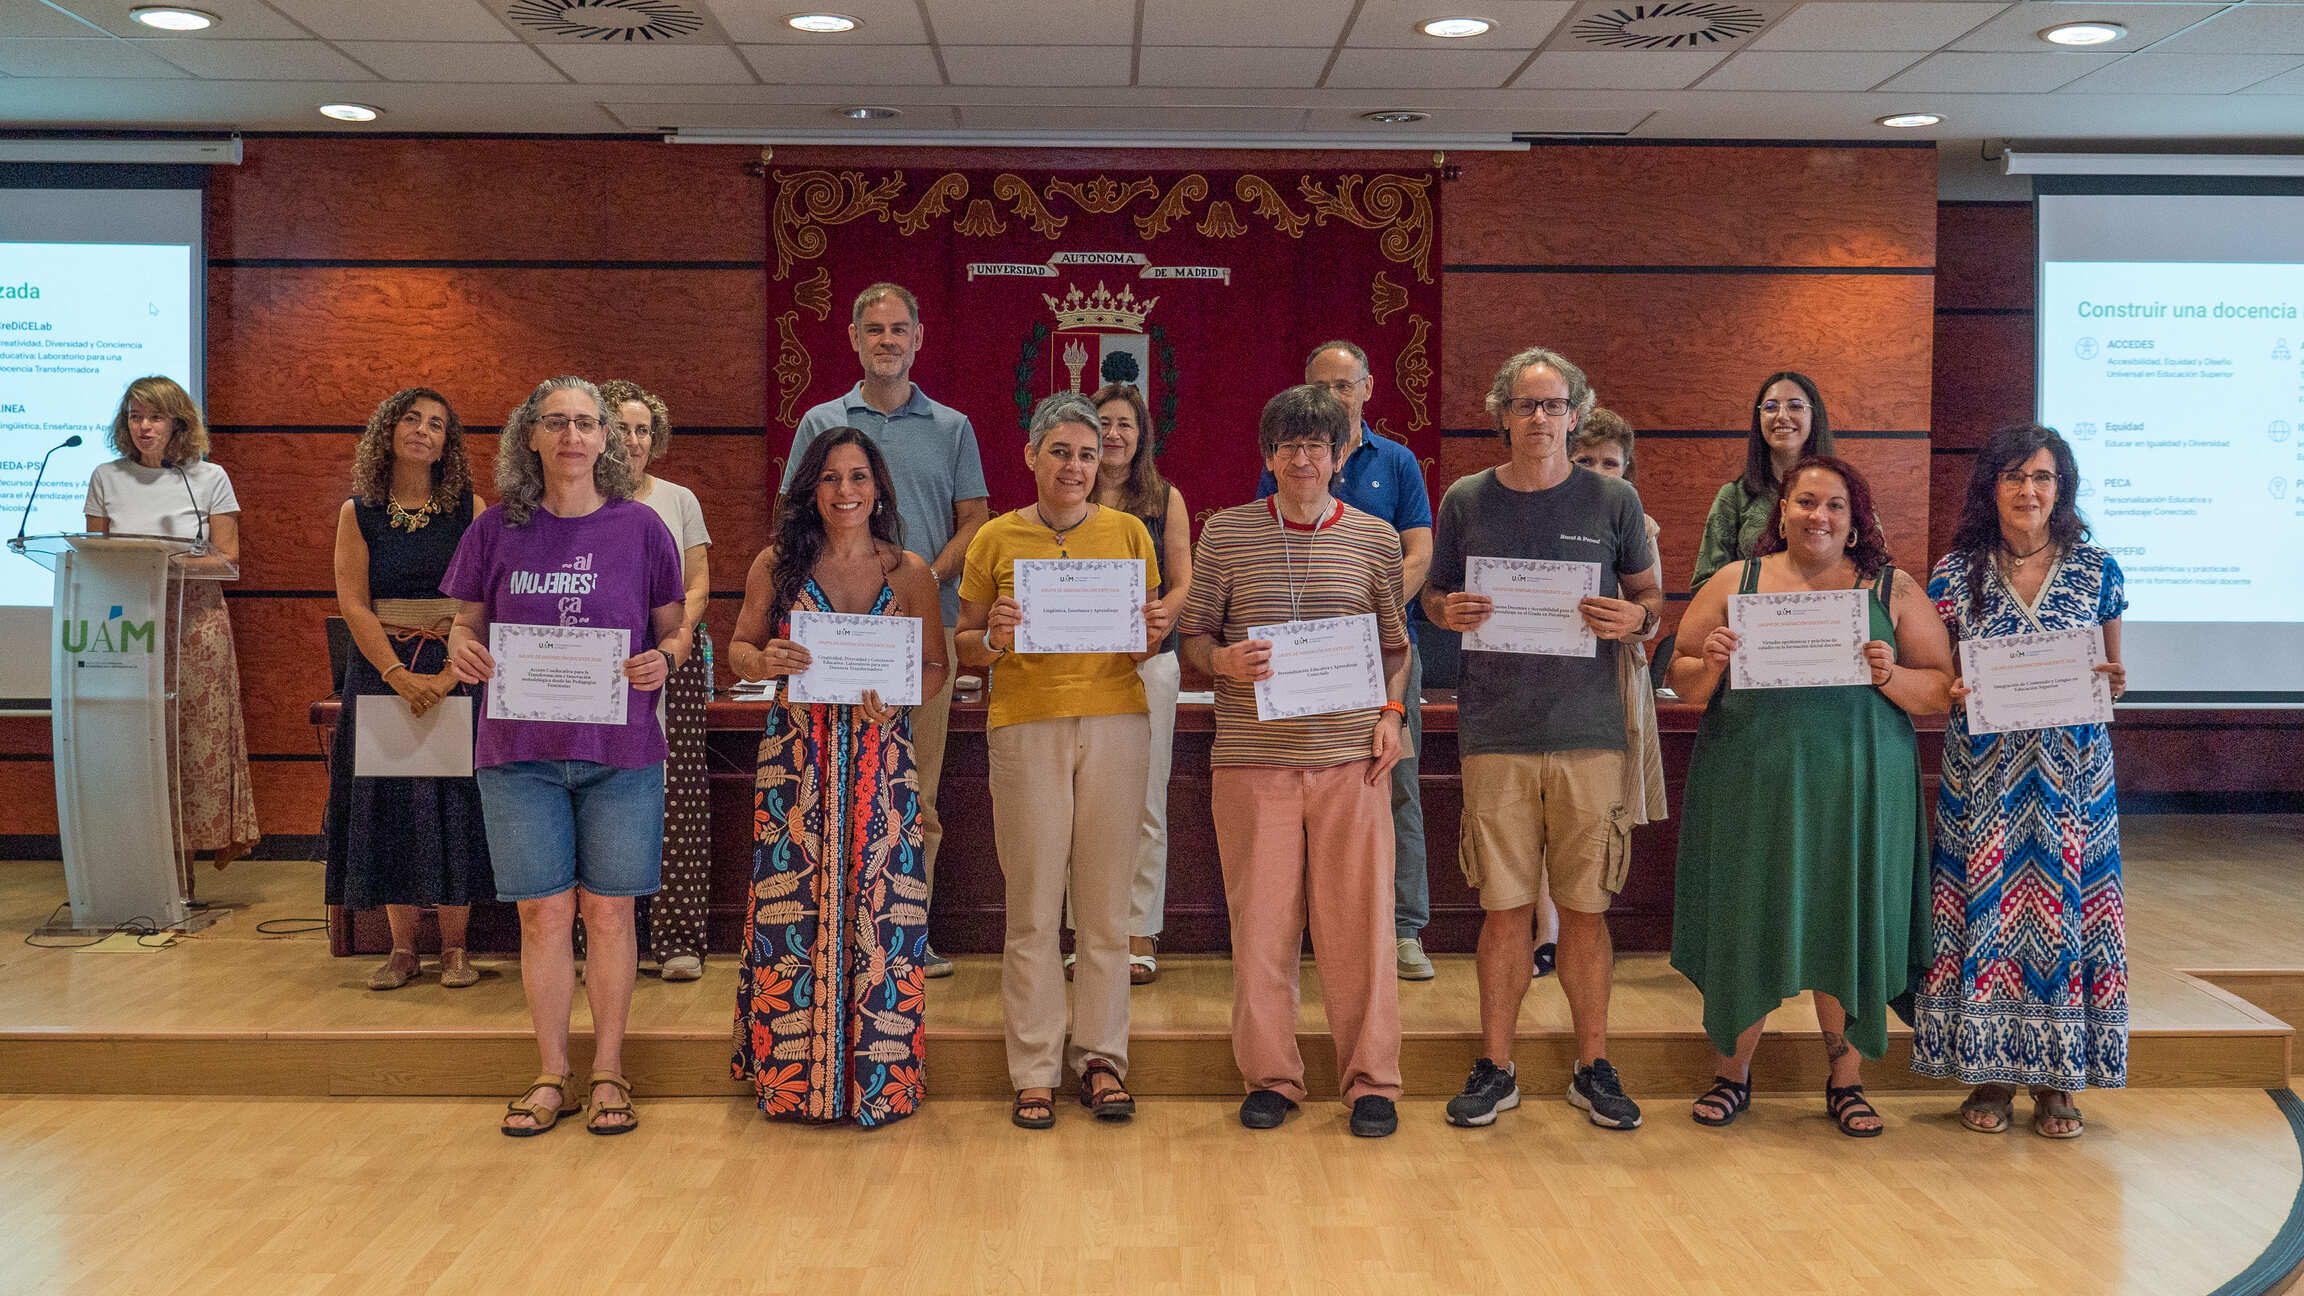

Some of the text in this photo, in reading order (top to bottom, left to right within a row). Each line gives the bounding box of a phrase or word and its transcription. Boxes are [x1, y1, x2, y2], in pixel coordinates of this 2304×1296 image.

[976, 253, 1219, 278] UNIVERSIDAD AUTONOMA DE MADRID
[2078, 301, 2297, 319] Construir una docencia
[2107, 340, 2154, 349] ACCEDES
[2105, 422, 2144, 432] Equidad
[2104, 479, 2131, 487] PECA
[62, 619, 155, 653] UAM
